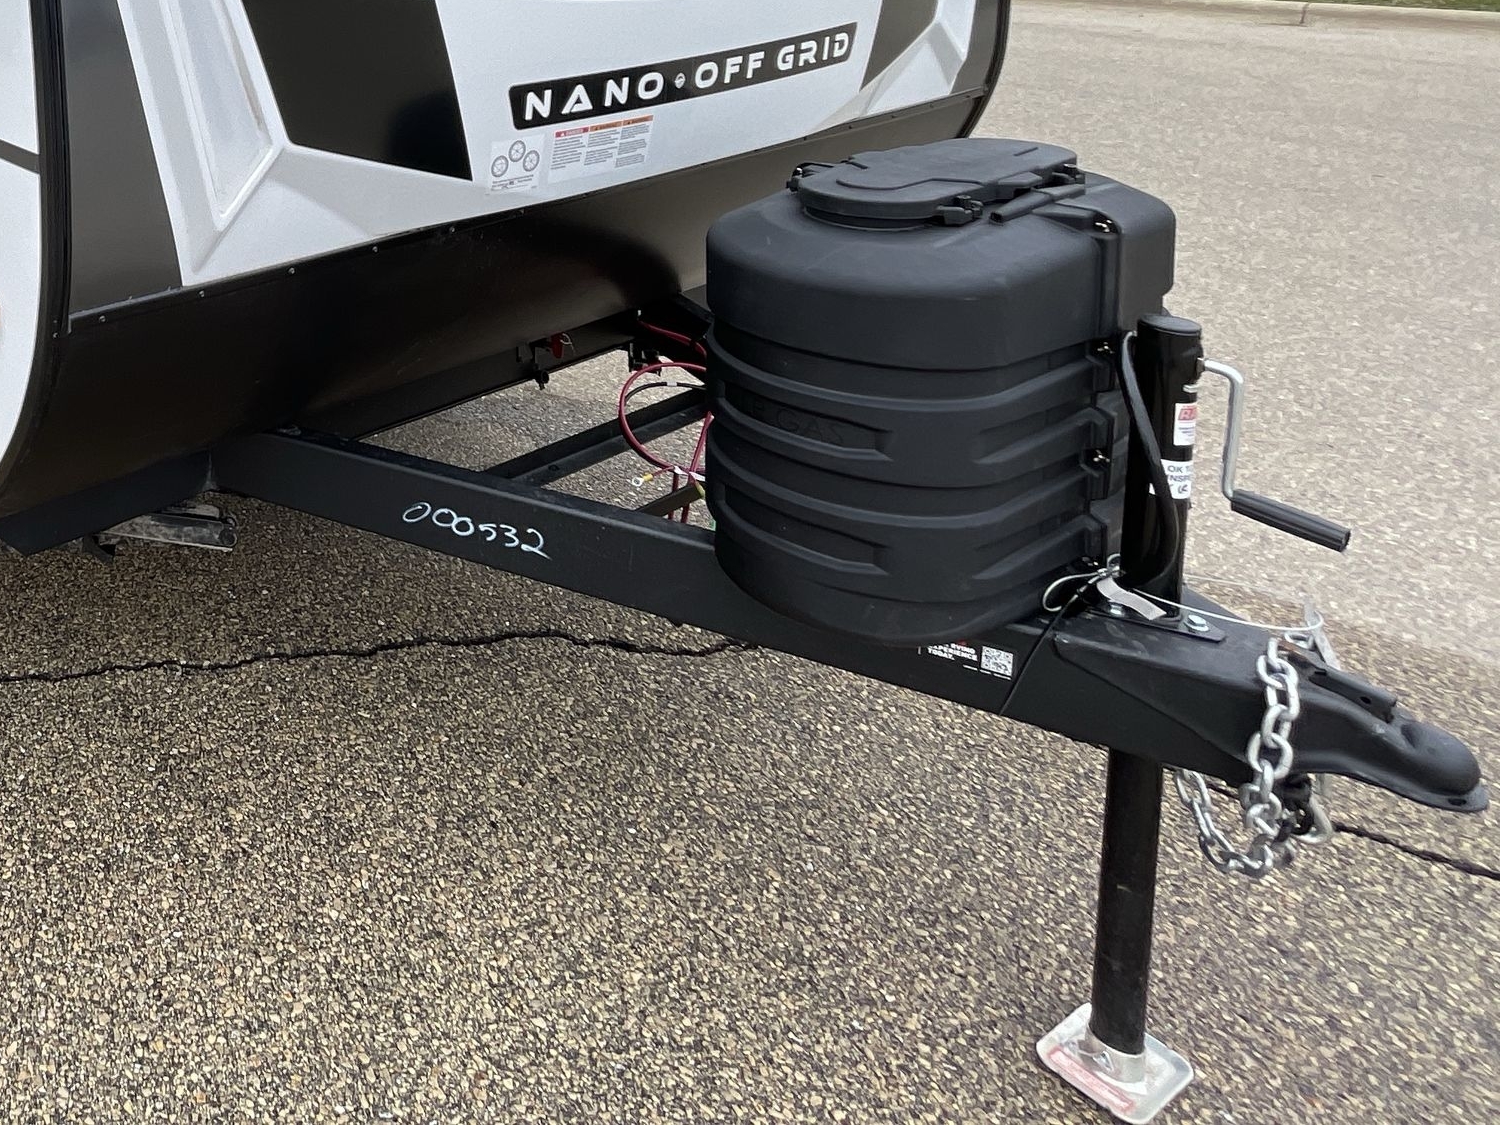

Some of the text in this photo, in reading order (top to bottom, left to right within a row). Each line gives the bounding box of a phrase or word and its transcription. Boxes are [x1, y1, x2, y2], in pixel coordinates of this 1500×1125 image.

[523, 31, 851, 121] NANO OFF GRID
[402, 501, 553, 562] 000532
